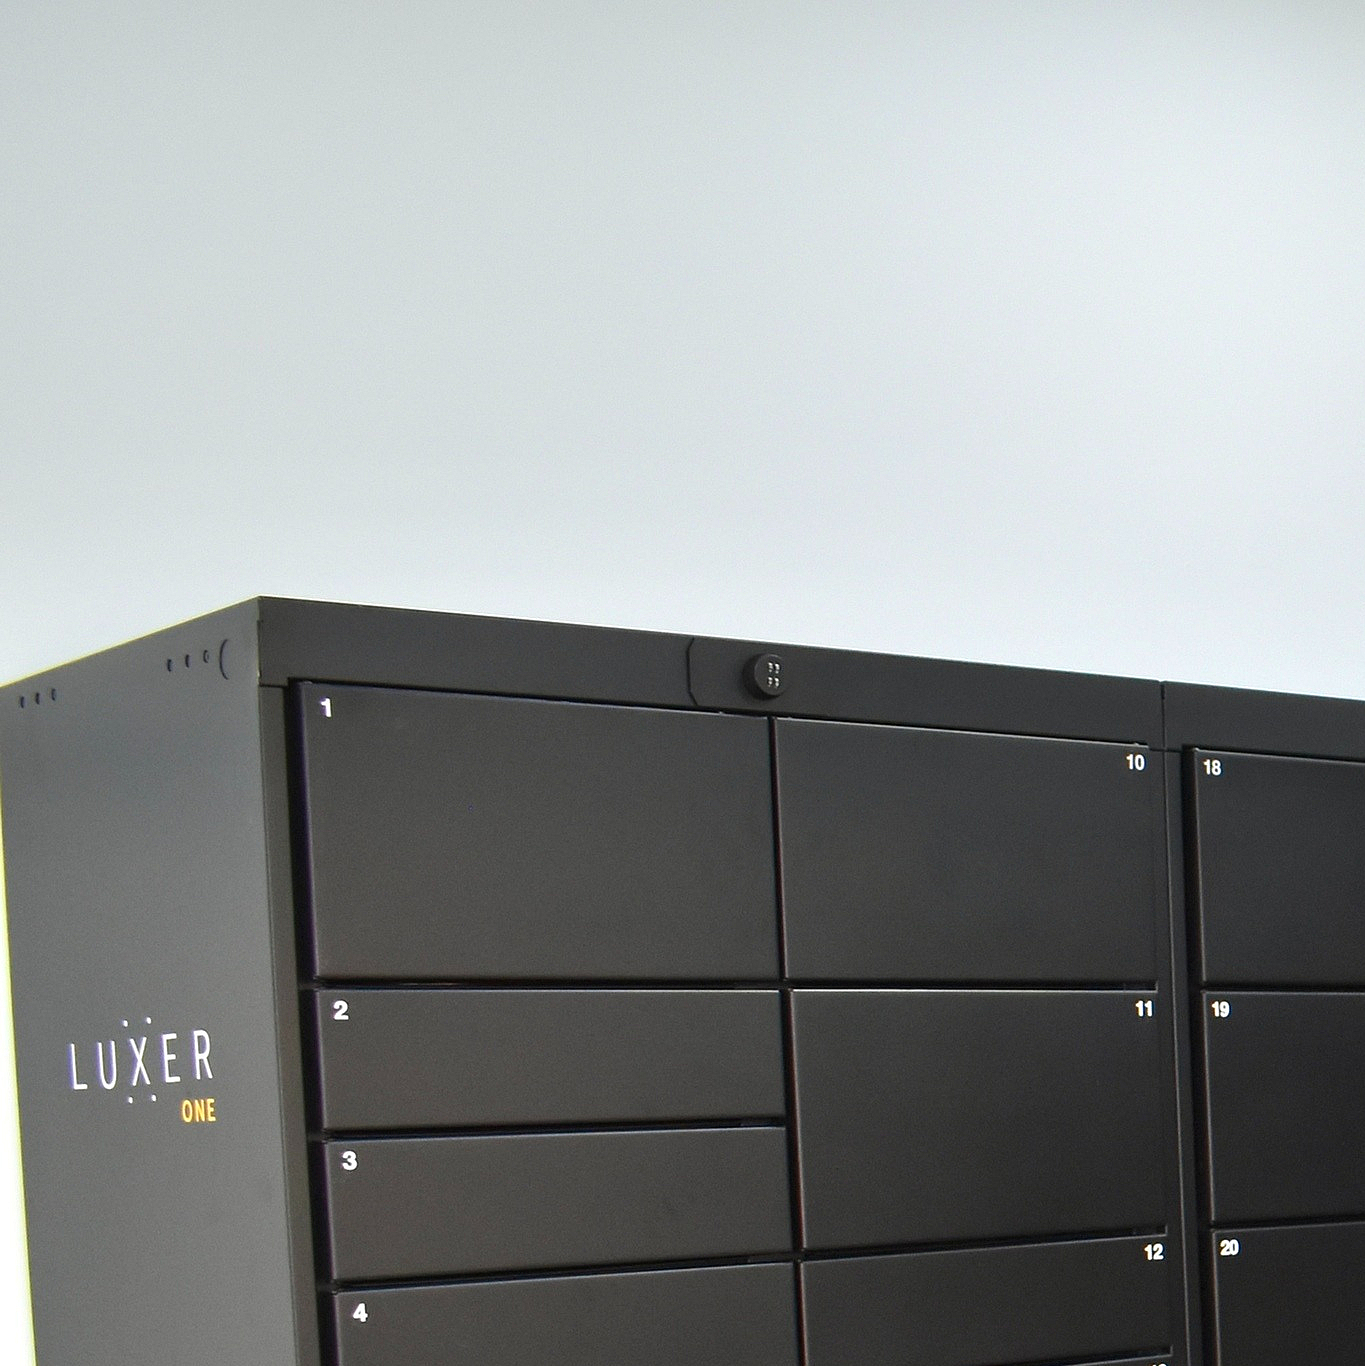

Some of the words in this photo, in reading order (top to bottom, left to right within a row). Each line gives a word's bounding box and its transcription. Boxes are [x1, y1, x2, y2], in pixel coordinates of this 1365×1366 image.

[321, 697, 332, 718] 1
[1125, 753, 1145, 771] 10
[1203, 758, 1222, 776] 18
[332, 999, 350, 1021] 2
[1135, 1000, 1153, 1017] 11
[1211, 1000, 1230, 1018] 19
[68, 1029, 214, 1091] LUXER
[180, 1098, 217, 1124] ONE
[340, 1150, 358, 1171] 3
[1143, 1243, 1164, 1261] 12
[1219, 1238, 1240, 1256] 20
[351, 1302, 369, 1323] 4
